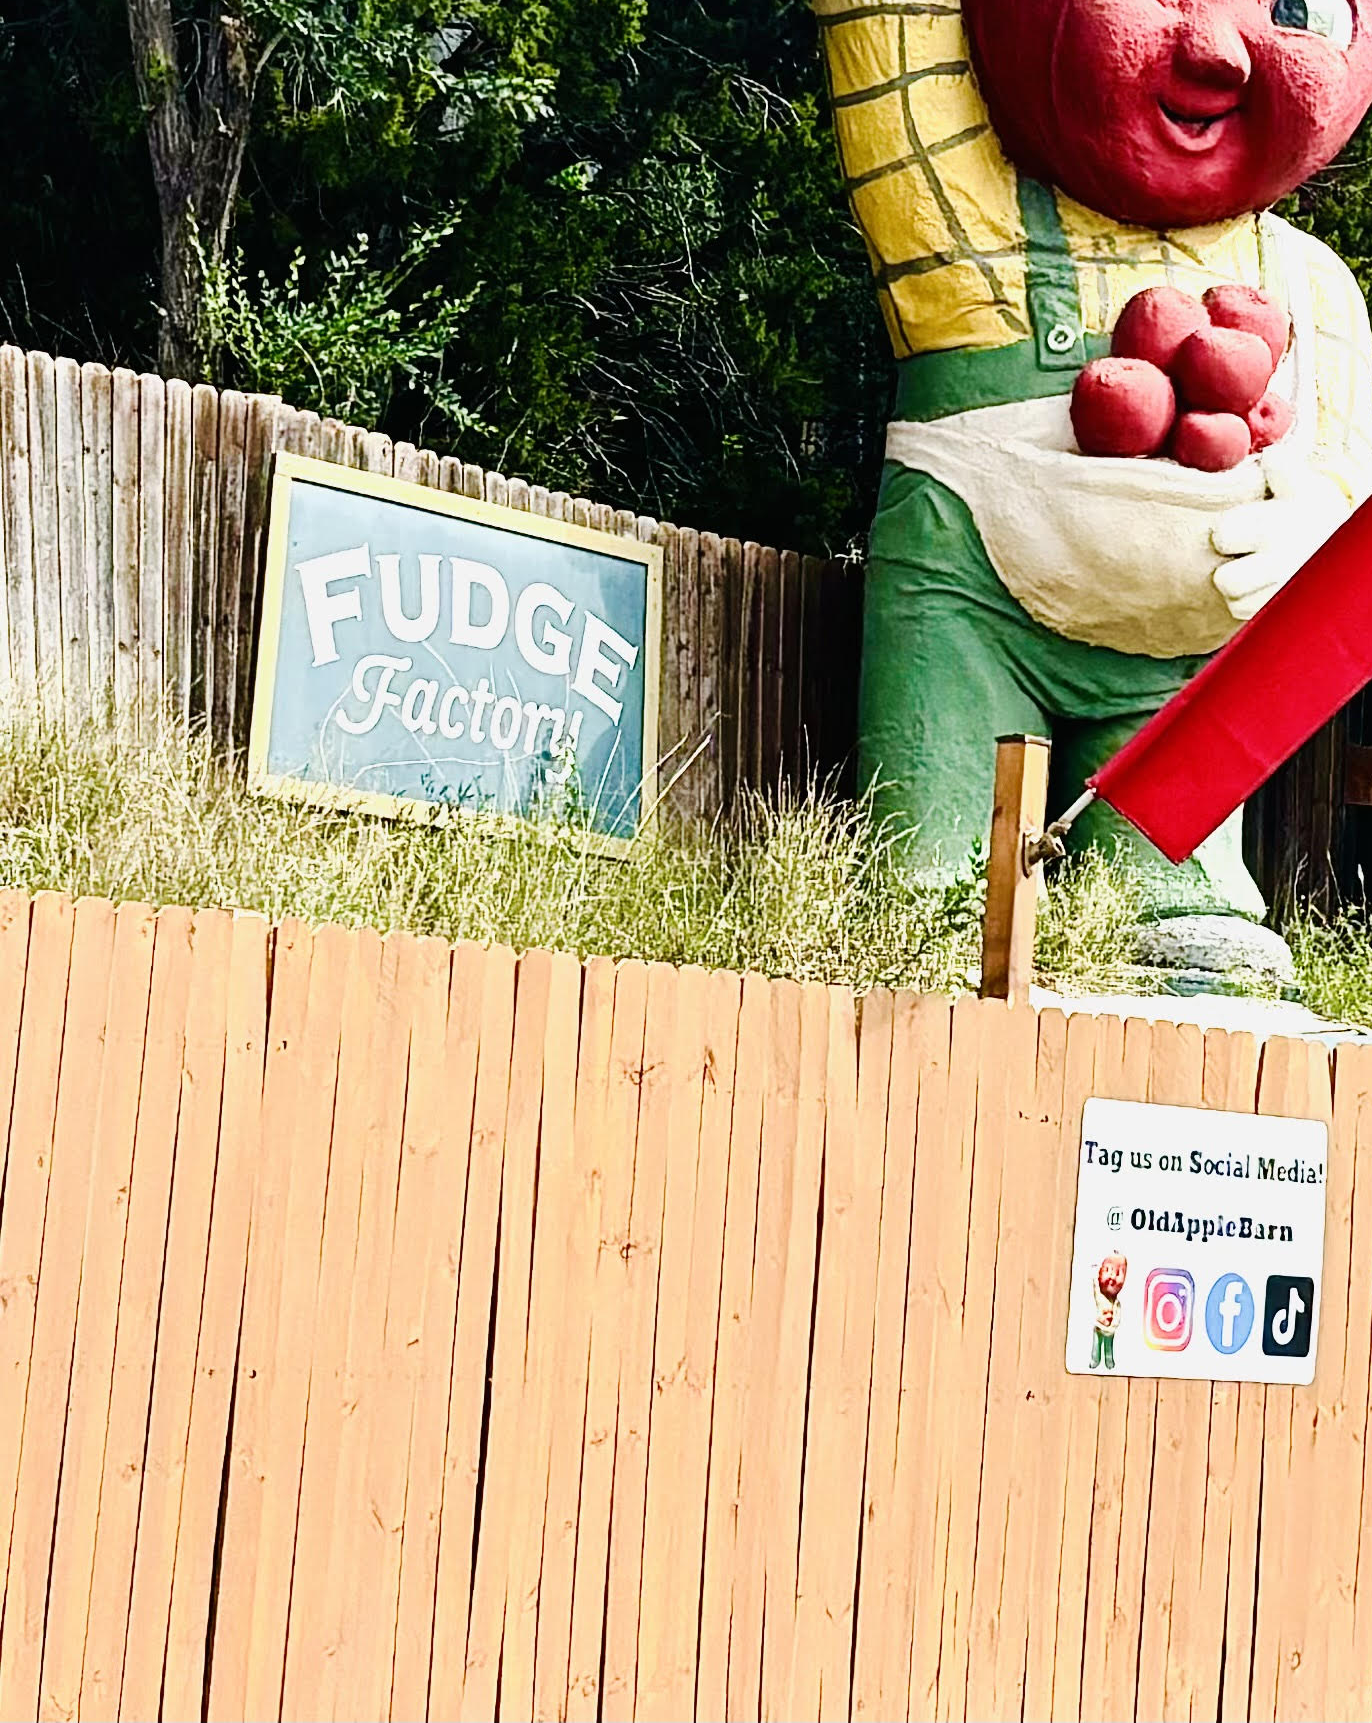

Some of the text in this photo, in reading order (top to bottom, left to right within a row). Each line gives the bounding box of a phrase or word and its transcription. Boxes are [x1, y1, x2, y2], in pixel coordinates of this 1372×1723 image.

[295, 542, 639, 726] FUDGE
[335, 654, 584, 783] Factory
[1085, 1141, 1323, 1184] Tag us on Social Media!
[1131, 1209, 1293, 1242] OldAppleBarn
